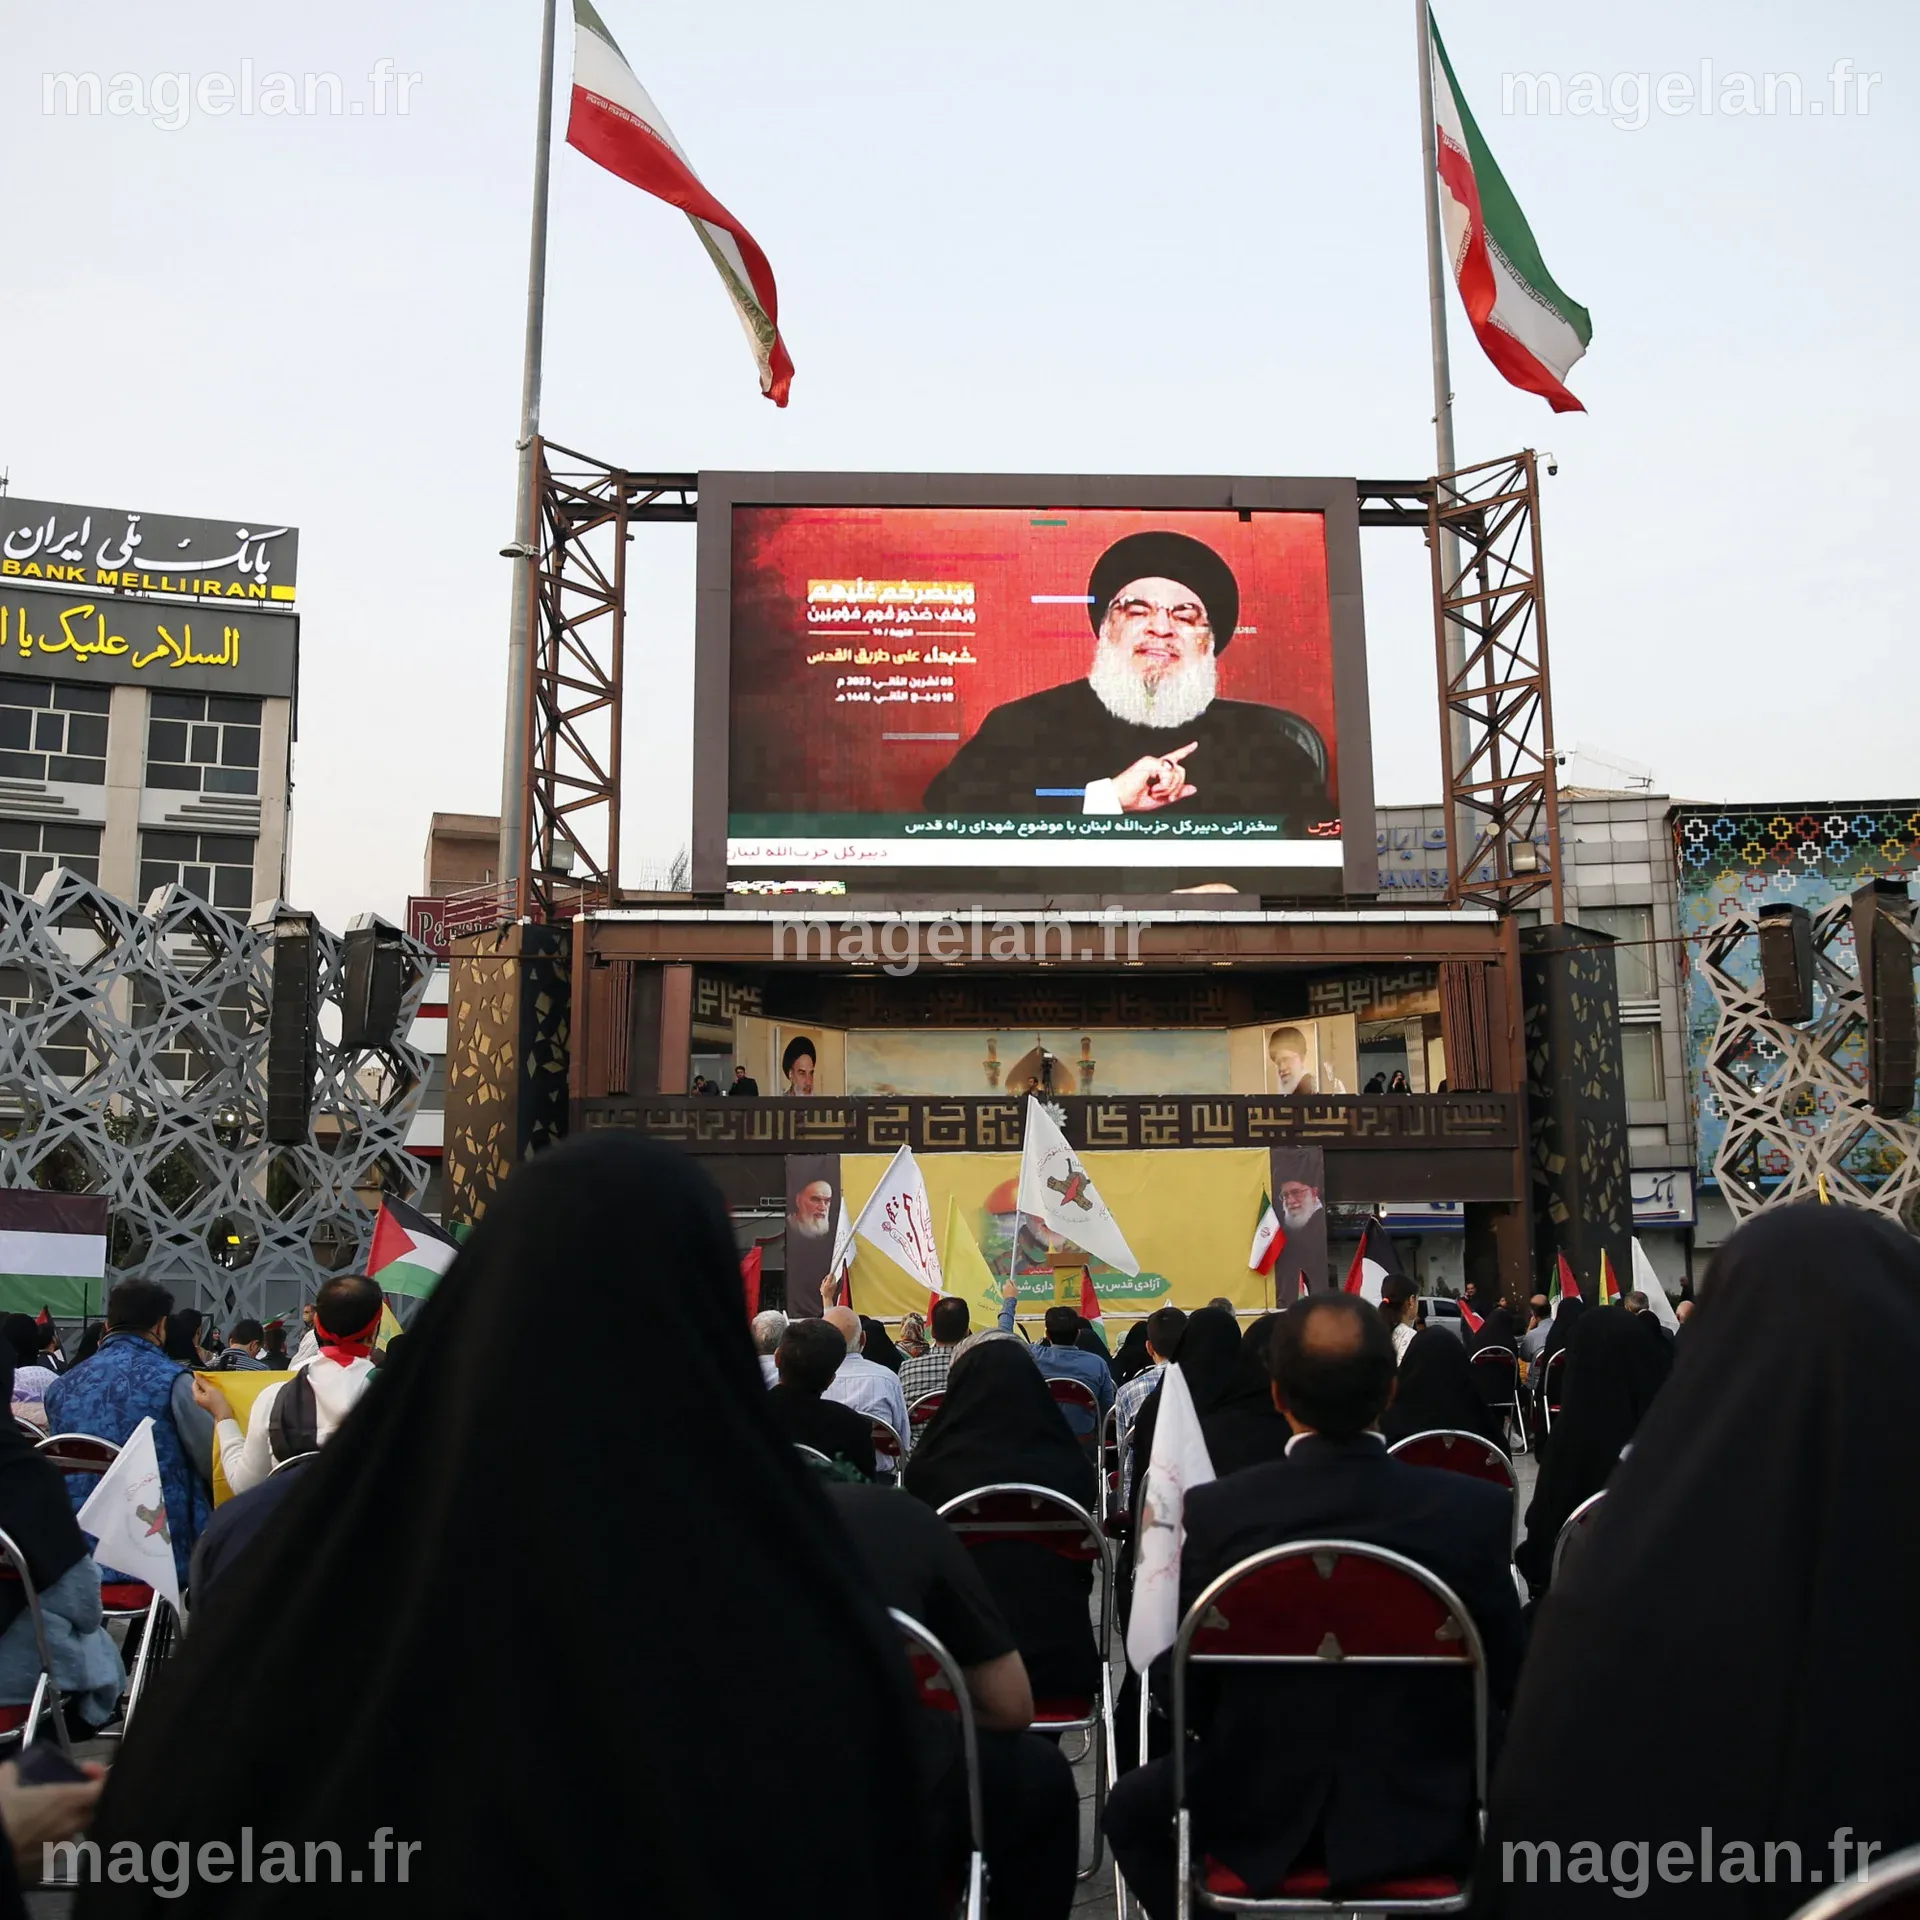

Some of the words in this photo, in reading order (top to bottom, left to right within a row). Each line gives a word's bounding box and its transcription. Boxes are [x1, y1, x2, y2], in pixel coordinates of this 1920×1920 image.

[4, 516, 90, 561] ایران
[2, 559, 86, 582] BANK
[97, 570, 186, 592] MELLI
[193, 578, 266, 598] IRAN
[131, 624, 240, 669] السلام
[807, 648, 852, 664] القدس
[905, 819, 942, 833] قدس
[946, 820, 966, 833] راه
[969, 819, 1015, 834] شهدای
[1017, 820, 1064, 837] موضوع
[1066, 820, 1077, 835] با
[1079, 820, 1112, 834] لبنان
[1172, 820, 1218, 836] دبیرکل
[1222, 820, 1277, 835] سخنرانی
[1106, 1278, 1133, 1293] قدس
[1134, 1277, 1161, 1292] آزادی
